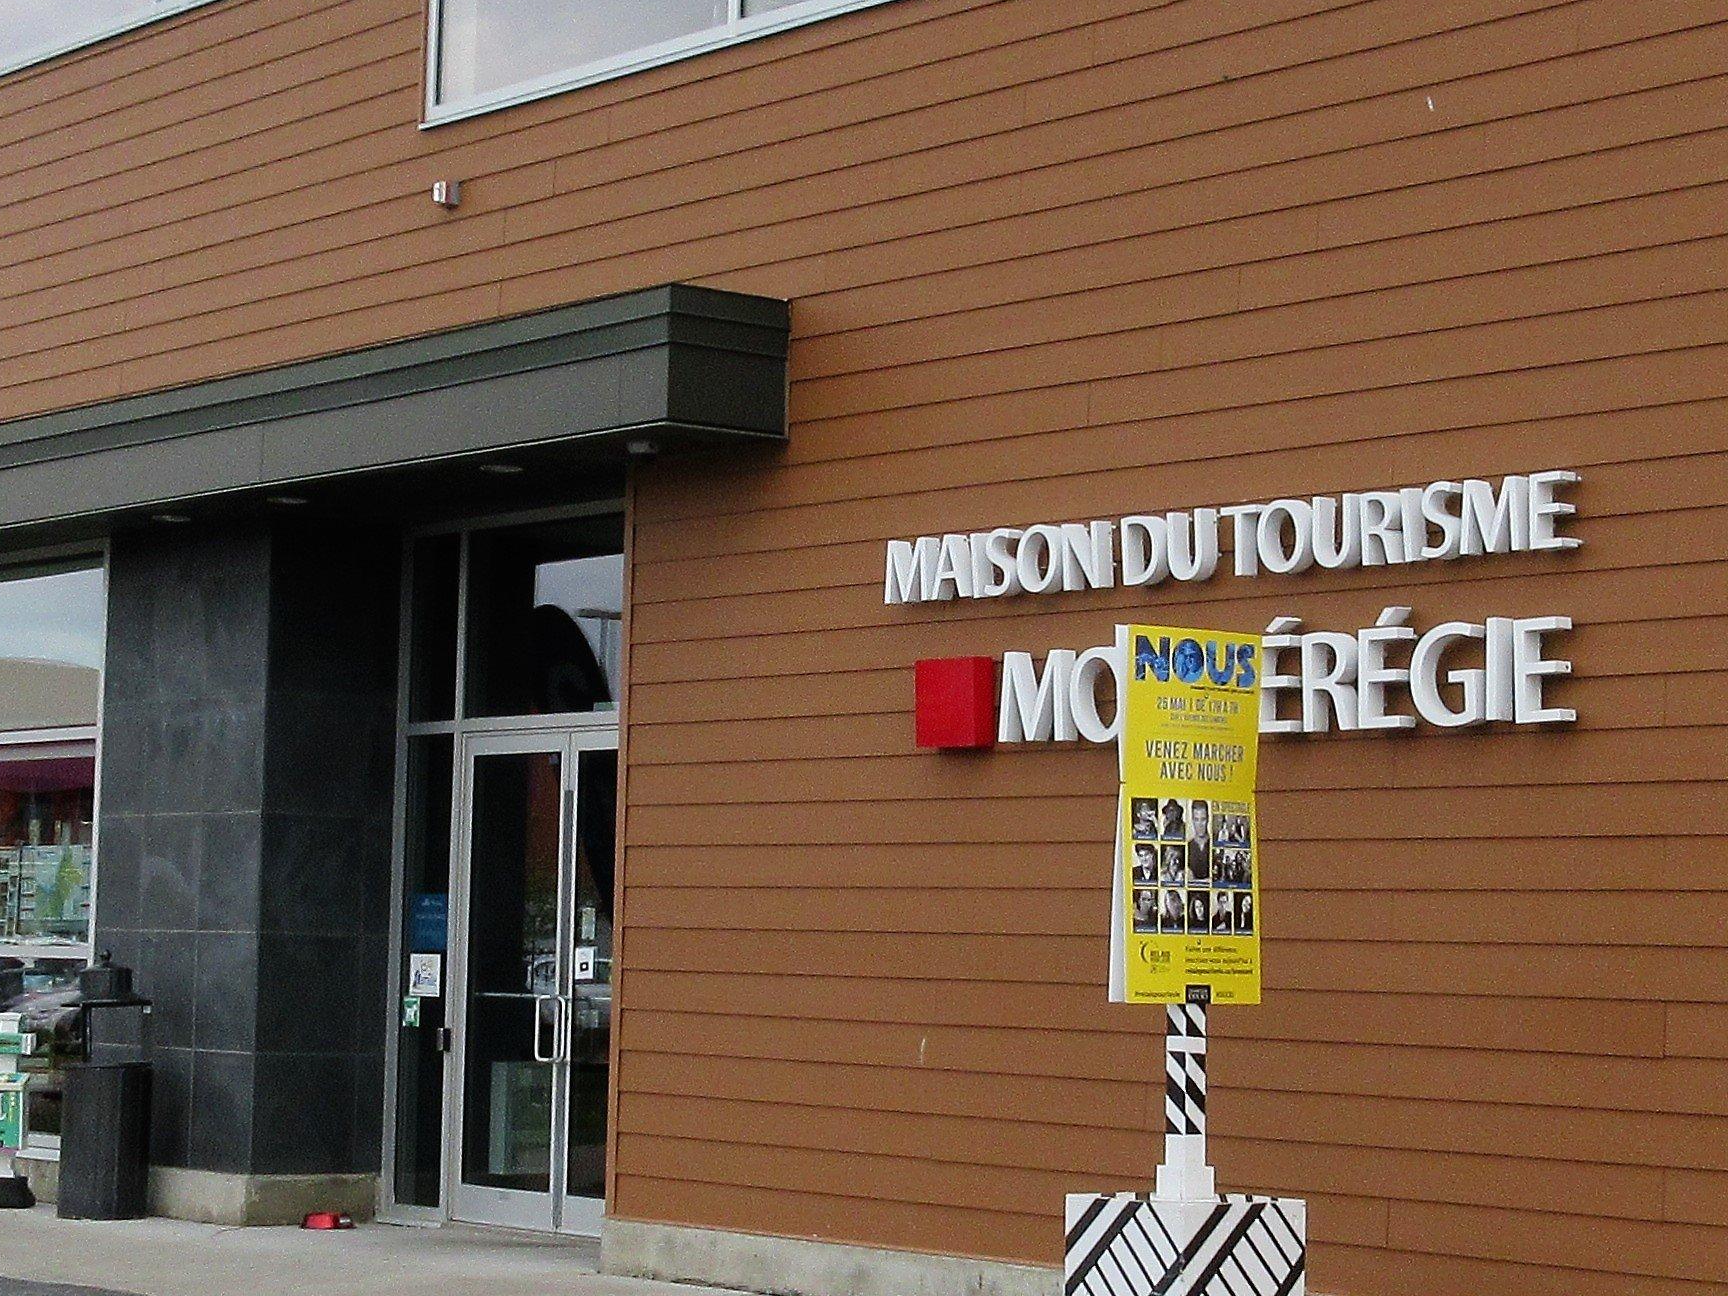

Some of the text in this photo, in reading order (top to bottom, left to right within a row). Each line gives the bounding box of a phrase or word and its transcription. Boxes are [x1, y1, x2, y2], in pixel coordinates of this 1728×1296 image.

[883, 470, 1582, 604] MAISON DU TOURISME
[998, 606, 1578, 744] MOÉRÉGIE
[1134, 634, 1256, 689] NOUS
[1145, 739, 1244, 764] VENEZ MARCHER
[1159, 761, 1193, 781] AVEC
[1197, 763, 1227, 782] NOUS
